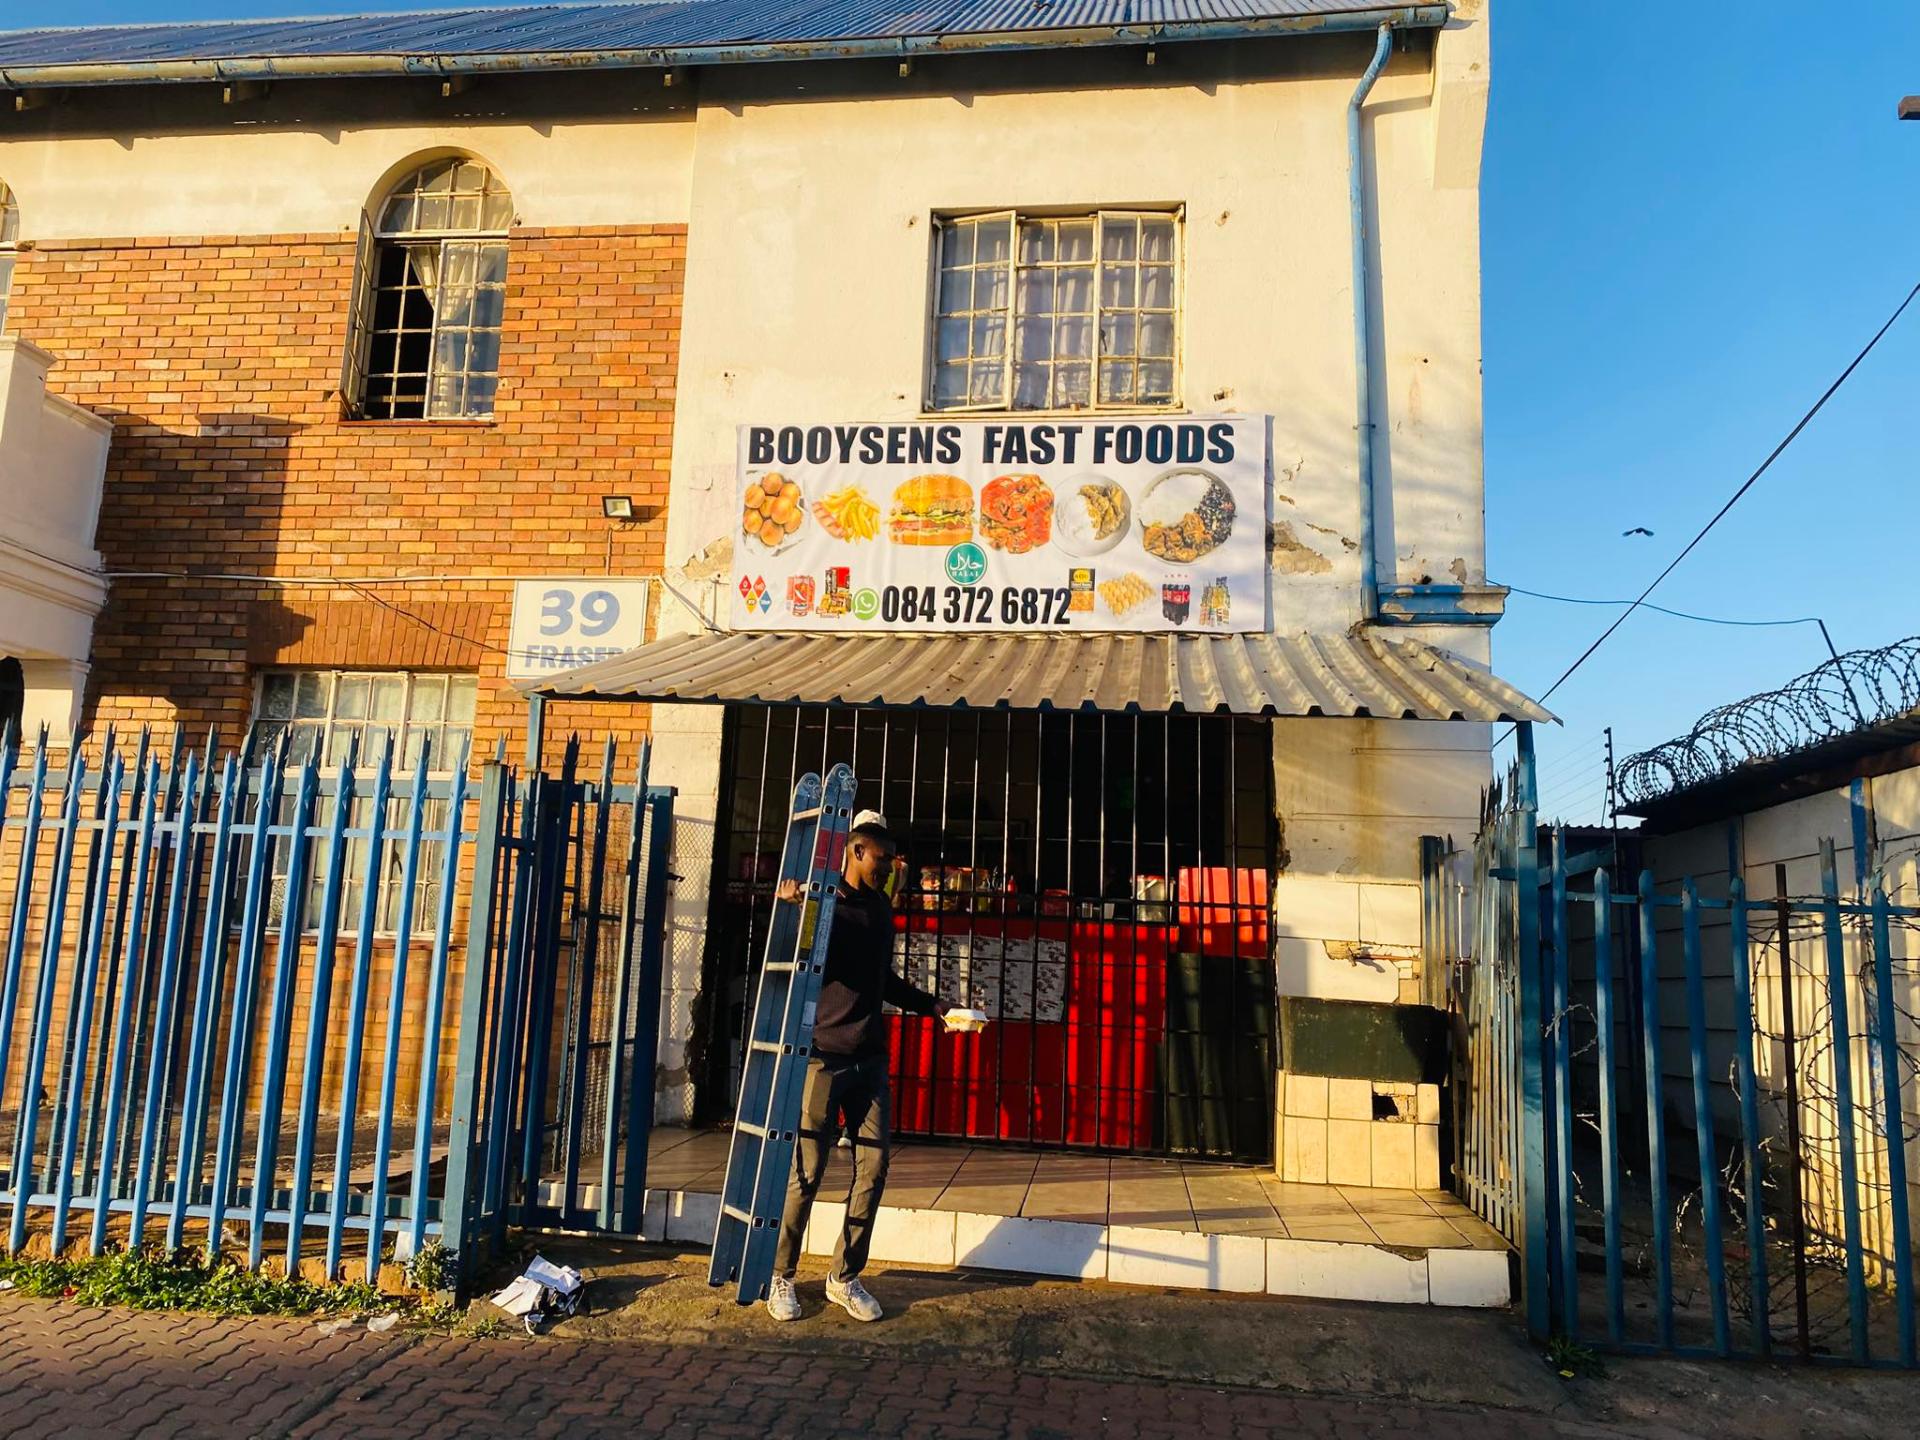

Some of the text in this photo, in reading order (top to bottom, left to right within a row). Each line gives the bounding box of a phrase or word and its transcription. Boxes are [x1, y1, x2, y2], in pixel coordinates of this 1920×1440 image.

[748, 423, 1235, 465] BOOYSENS FAST FOODS
[540, 589, 620, 637] 39
[881, 585, 1071, 625] 084 372 6872
